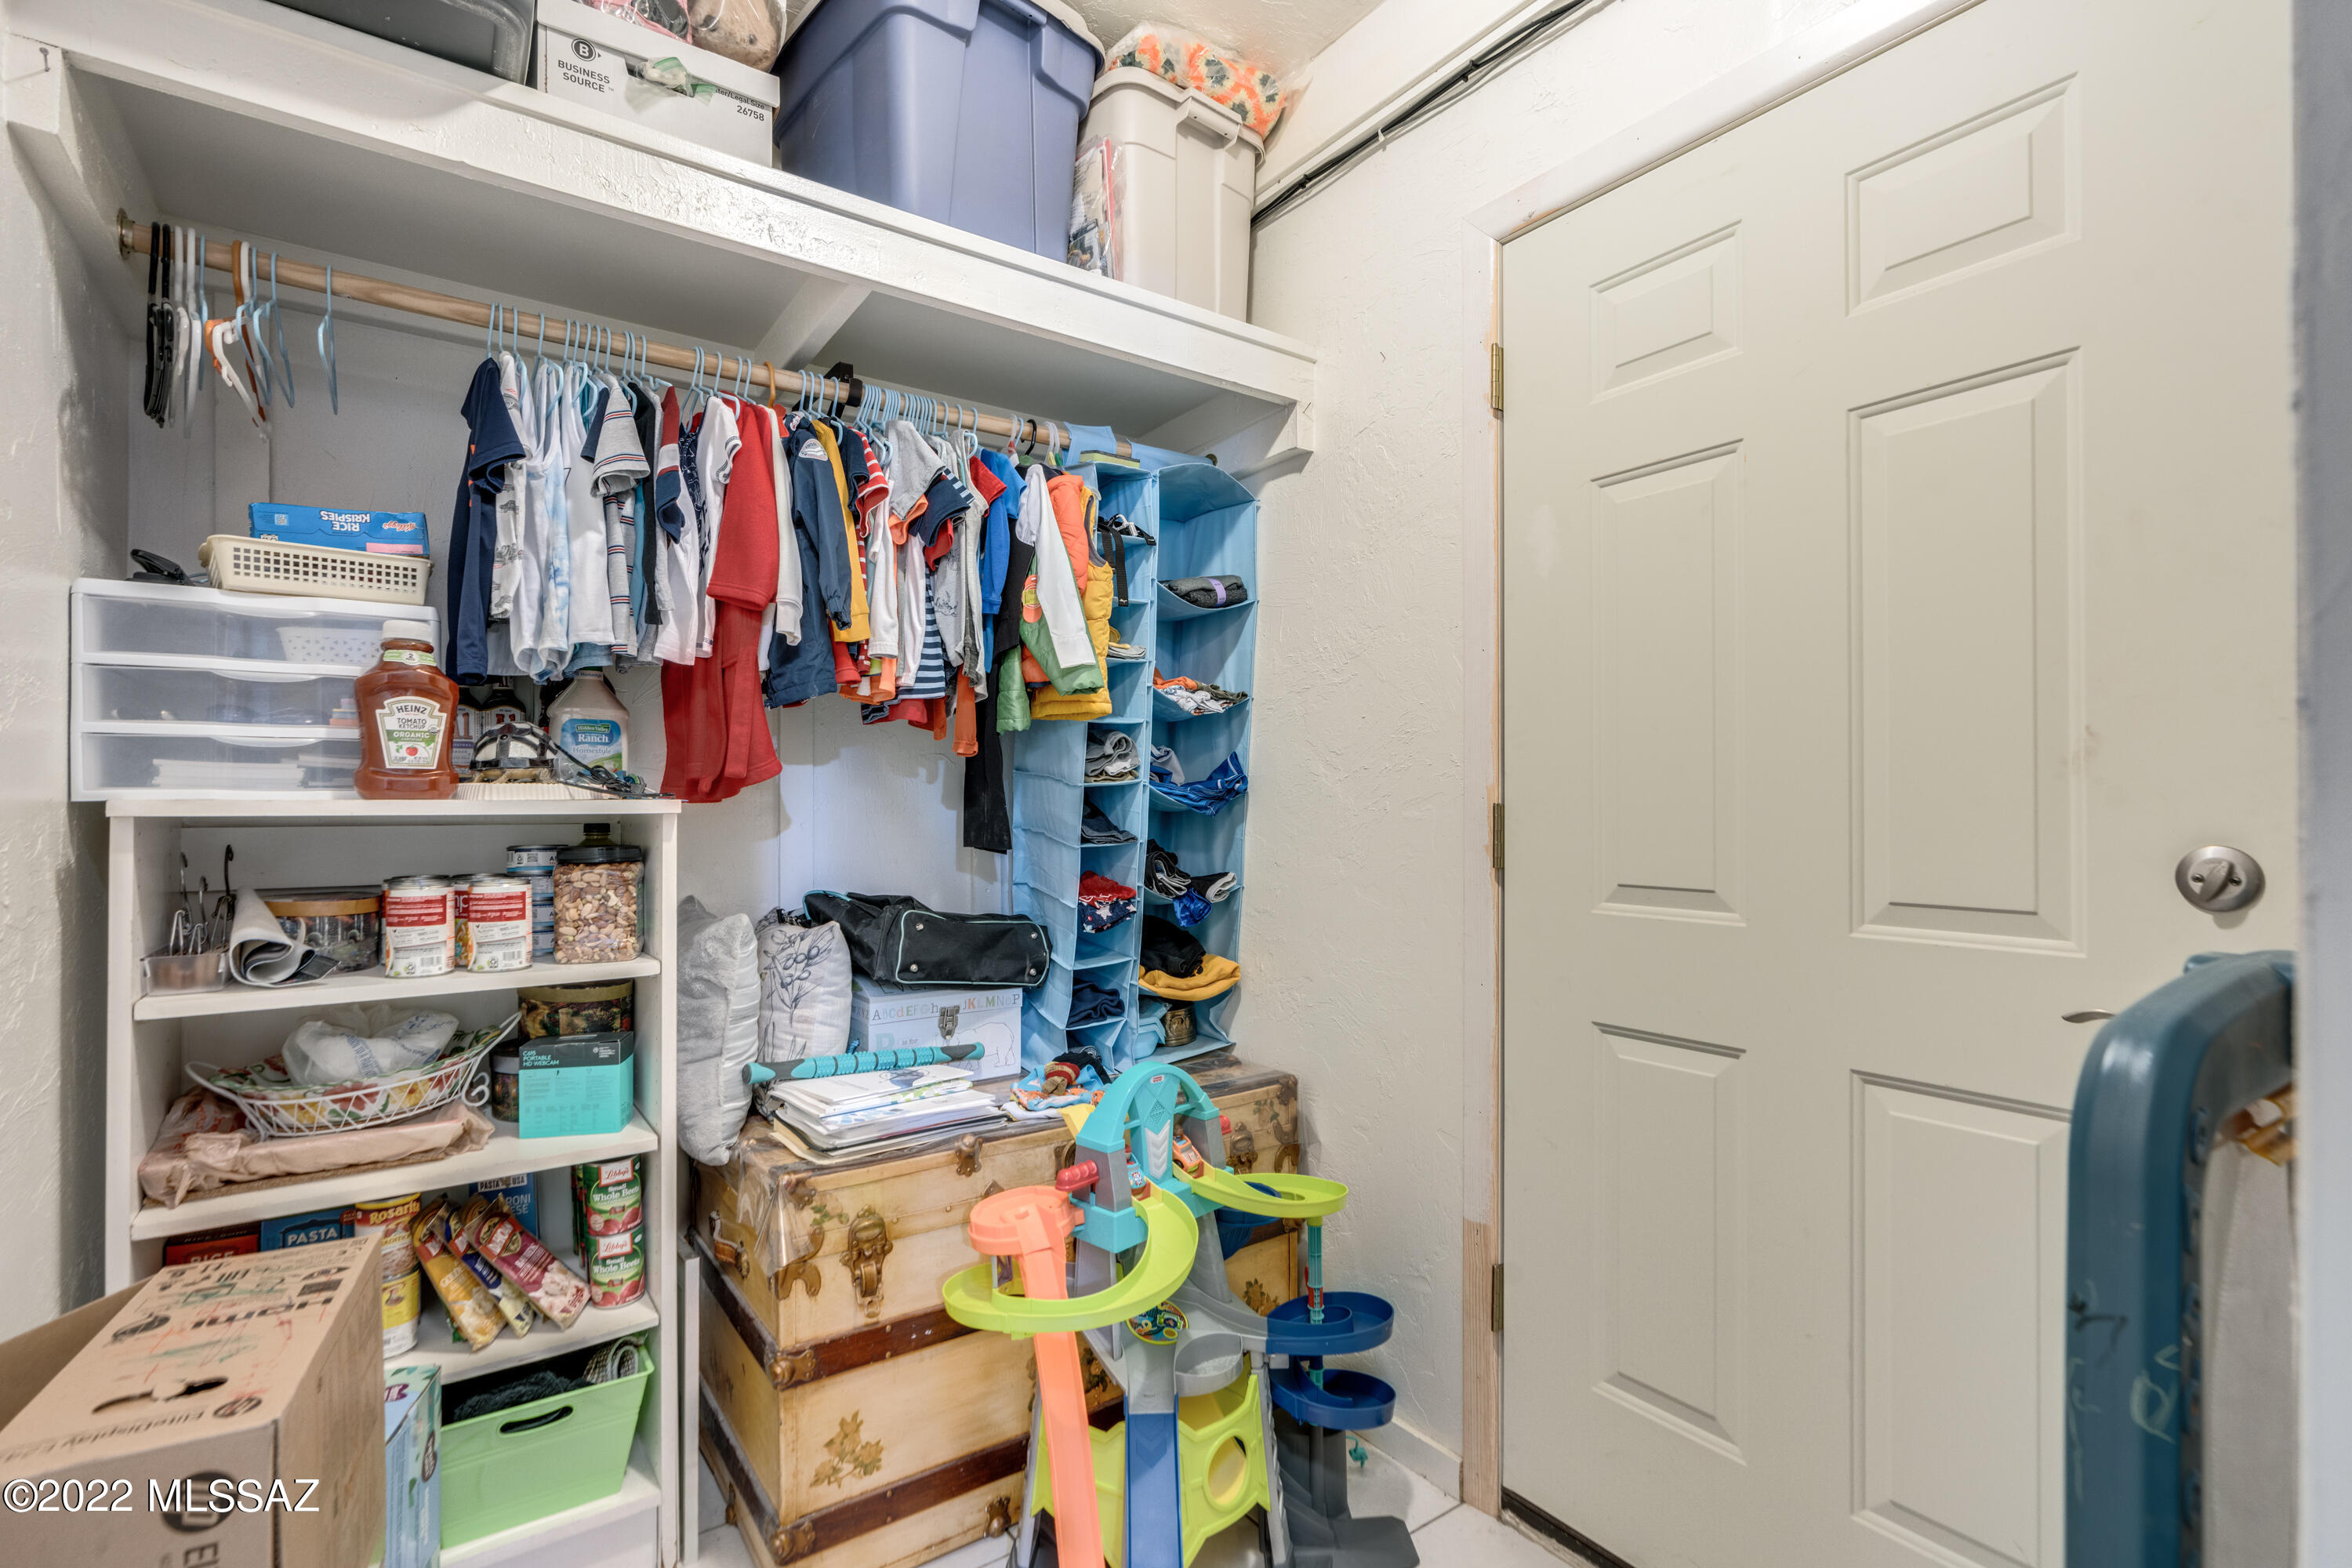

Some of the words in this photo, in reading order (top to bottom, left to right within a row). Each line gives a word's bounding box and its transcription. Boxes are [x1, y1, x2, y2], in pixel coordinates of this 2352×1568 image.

[558, 60, 610, 84] BUSINESS
[563, 72, 605, 93] SOURCE
[750, 100, 764, 110] Size
[737, 105, 764, 122] 26758
[320, 510, 371, 524] KRISPIES
[332, 521, 360, 532] RICE
[383, 521, 416, 532] Kellogg's
[396, 705, 427, 714] HEINZ
[578, 733, 608, 742] Ranch
[605, 1166, 630, 1181] Libby's
[479, 1180, 500, 1192] PASTA
[511, 1175, 525, 1185] USA
[608, 1182, 626, 1192] Small
[593, 1189, 620, 1203] Whole
[622, 1185, 640, 1198] Beets
[287, 1226, 338, 1247] PASTA
[604, 1240, 628, 1254] Libby's
[593, 1264, 619, 1274] Whole
[619, 1259, 640, 1271] Beets
[606, 1256, 625, 1265] Small
